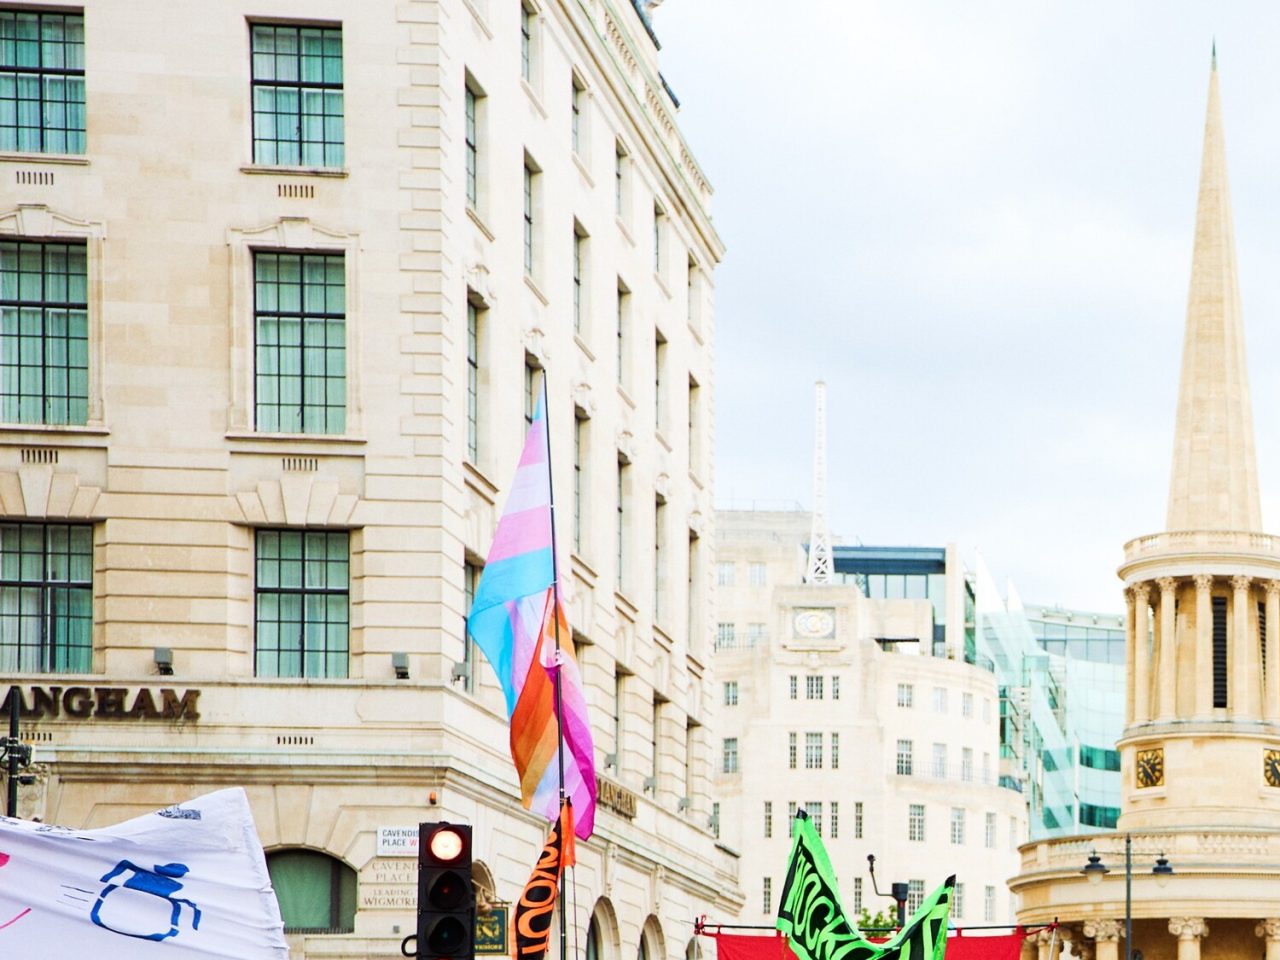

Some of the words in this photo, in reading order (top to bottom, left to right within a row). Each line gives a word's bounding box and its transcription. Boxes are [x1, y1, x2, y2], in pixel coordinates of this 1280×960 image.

[0, 685, 201, 719] ANGHAM
[382, 829, 419, 837] CAVENDIS
[382, 838, 406, 846] PLACE
[376, 873, 411, 881] PLACE
